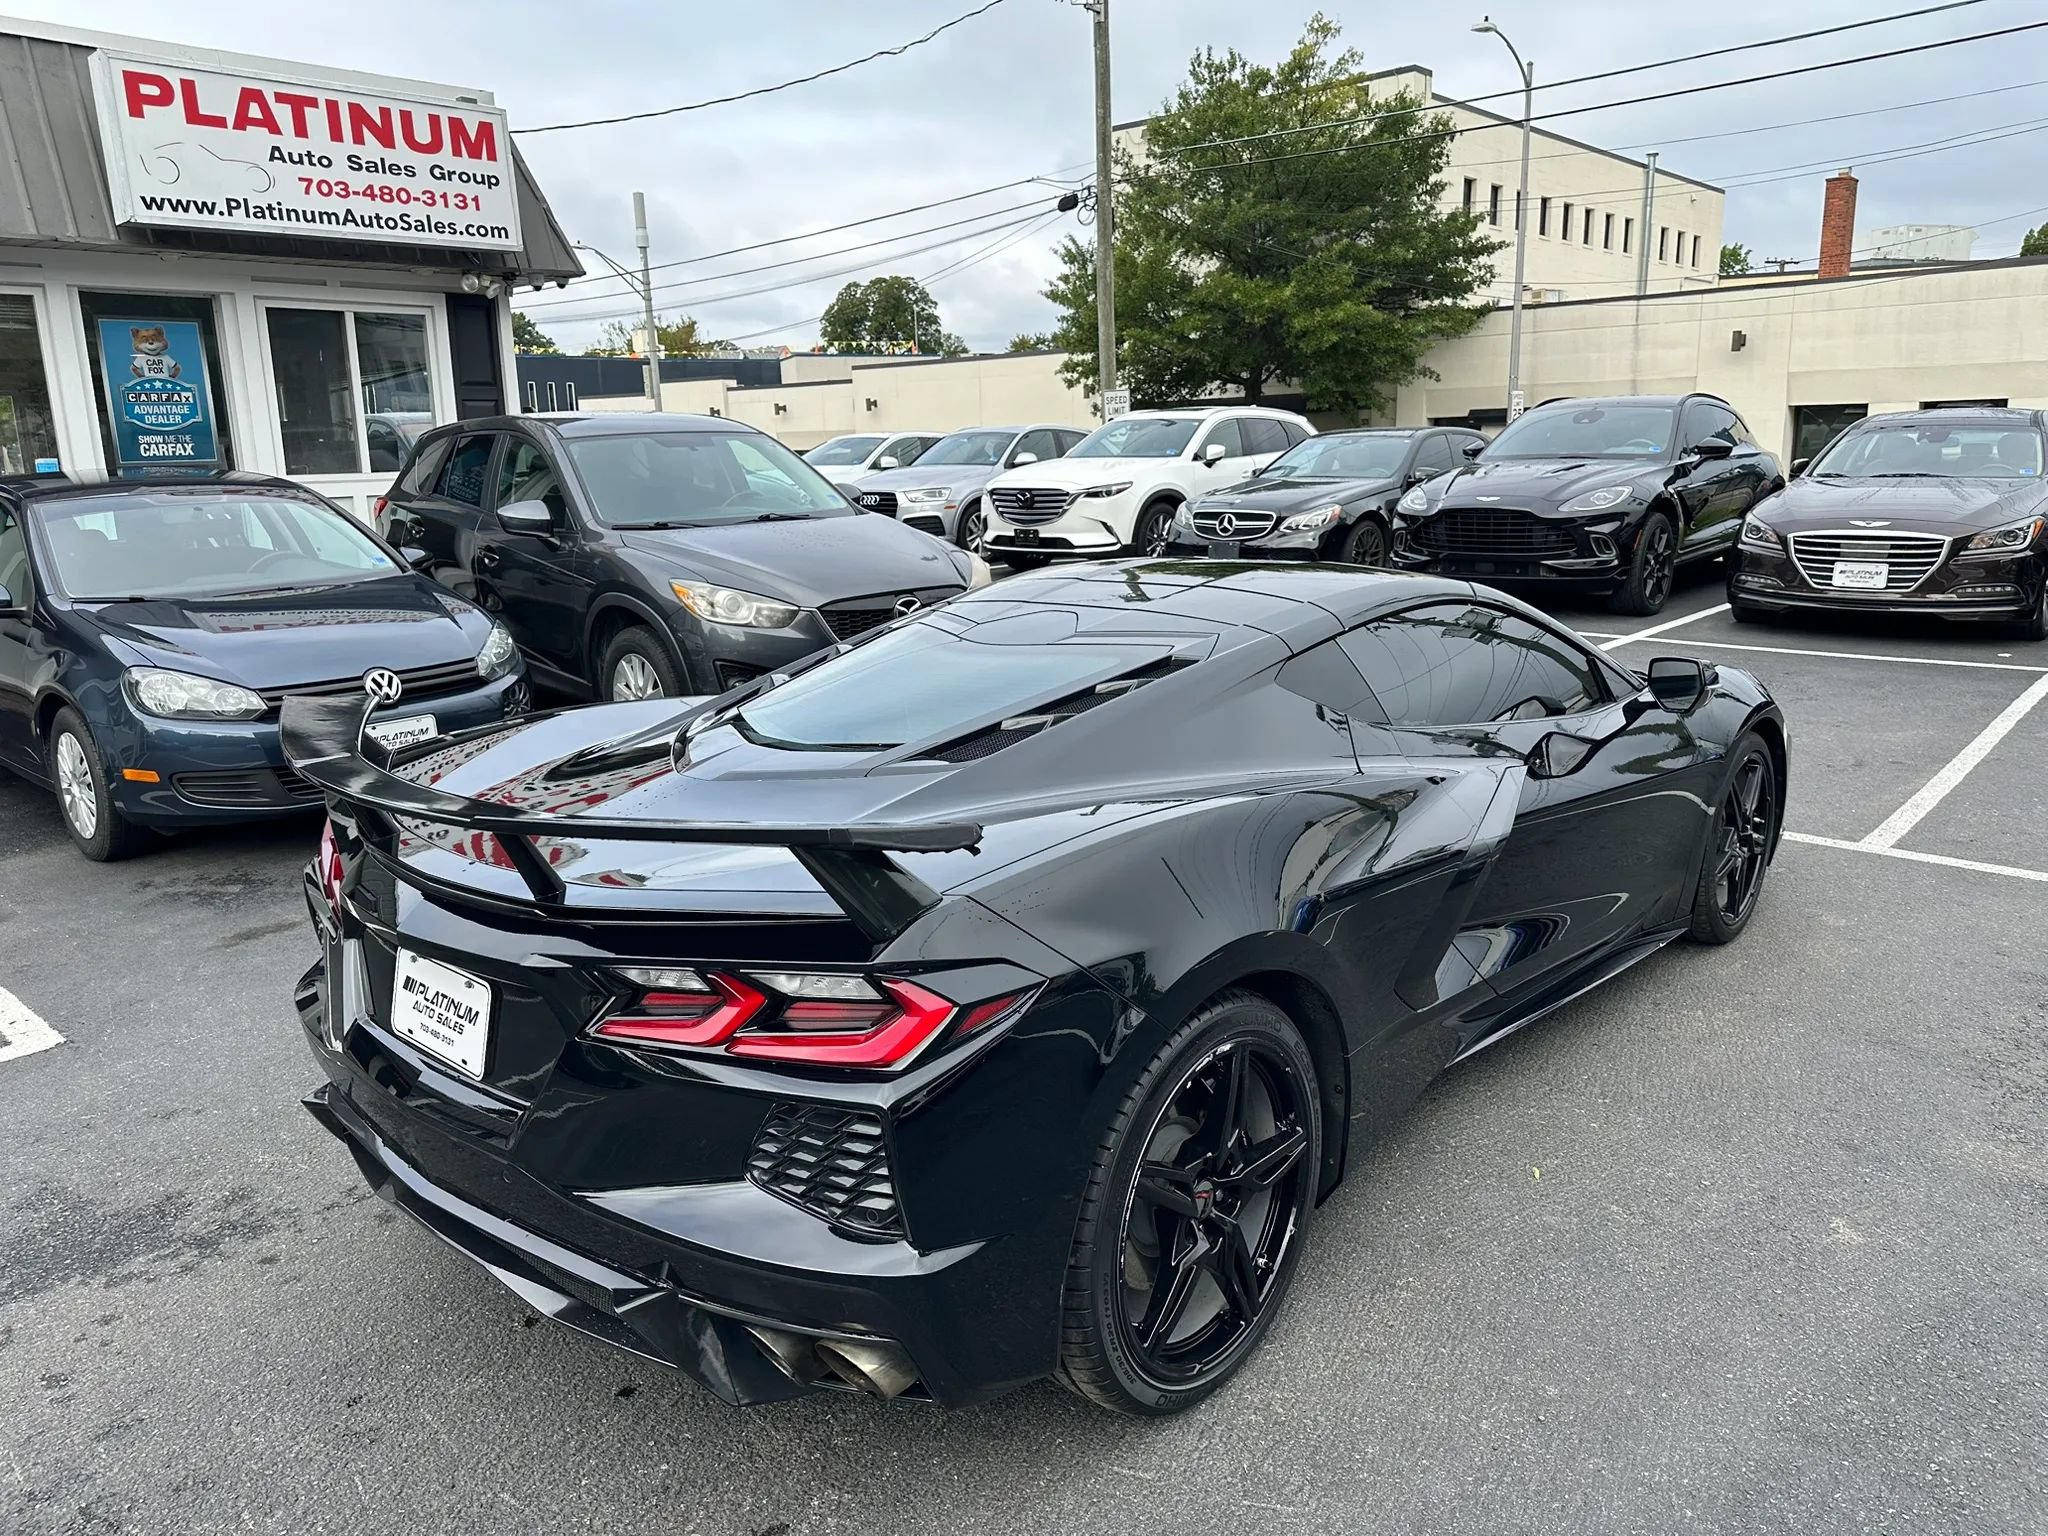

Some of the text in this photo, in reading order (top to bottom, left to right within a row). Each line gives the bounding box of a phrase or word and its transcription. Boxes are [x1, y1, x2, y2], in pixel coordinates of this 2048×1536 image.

[122, 70, 498, 162] PLATINUM
[268, 145, 500, 190] Auto Sales Group
[298, 177, 481, 212] 703-480-3131
[139, 195, 509, 240] www.PlatinumAutoSales.com
[146, 359, 164, 367] CAR
[127, 393, 193, 403] CARFAX
[1105, 396, 1128, 405] SPEED
[134, 405, 191, 415] ADVANTAGE
[1107, 406, 1126, 416] LIMIT
[145, 415, 183, 424] DEALER
[138, 435, 193, 444] SHOW ME THE
[140, 443, 195, 457] CARFAX
[380, 727, 429, 742] PLATINUM
[415, 982, 480, 1027] PLATINUM
[412, 1000, 465, 1036] AUTO SALES
